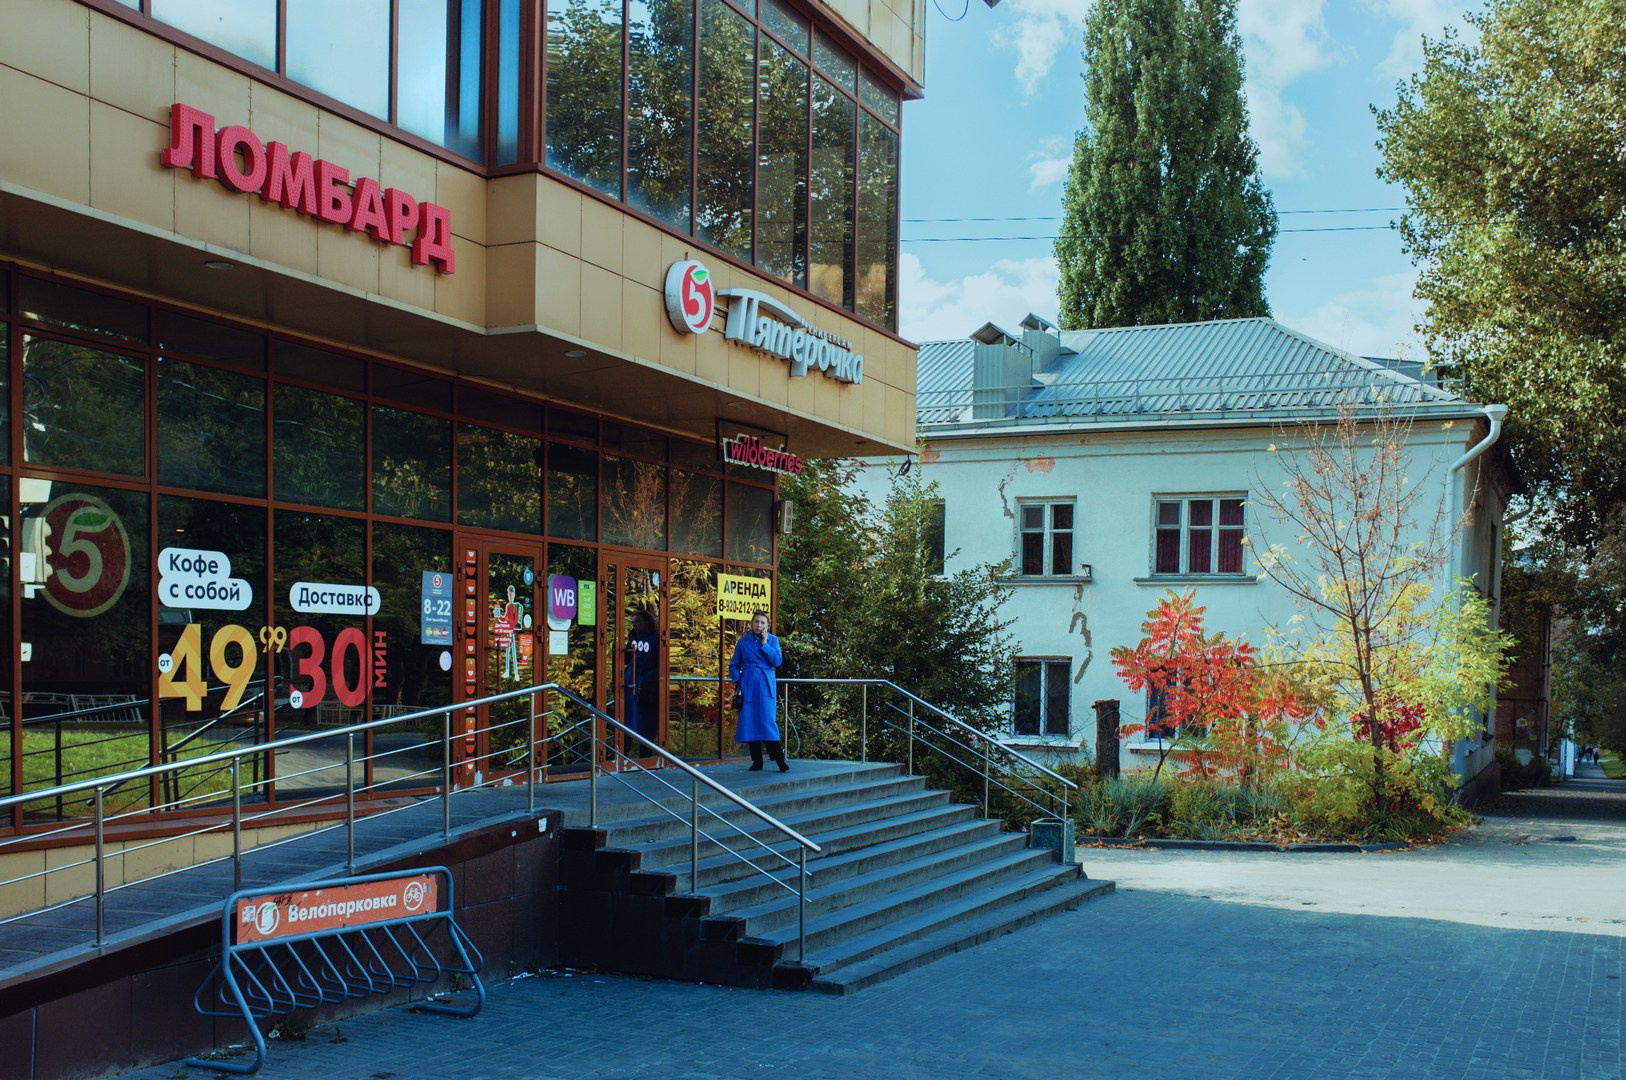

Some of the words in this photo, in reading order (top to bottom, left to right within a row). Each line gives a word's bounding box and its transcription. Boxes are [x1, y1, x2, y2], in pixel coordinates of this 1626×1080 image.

[161, 103, 455, 274] ЛОМБАРД
[687, 276, 708, 325] 5
[717, 288, 864, 385] Пятерочка
[808, 324, 852, 349] УНИВЕРСАМ
[731, 437, 802, 475] wildberries
[56, 507, 110, 593] 5
[169, 553, 219, 578] Кофе
[169, 583, 179, 598] с
[185, 581, 240, 601] собой
[298, 587, 374, 607] Доставка
[554, 588, 575, 607] WB
[723, 580, 766, 599] АРЕНДА
[424, 599, 451, 616] 8-22
[159, 624, 257, 711] 49
[259, 626, 287, 653] 99
[289, 626, 373, 708] 30
[292, 696, 301, 704] от
[288, 893, 397, 923] Велопарковка
